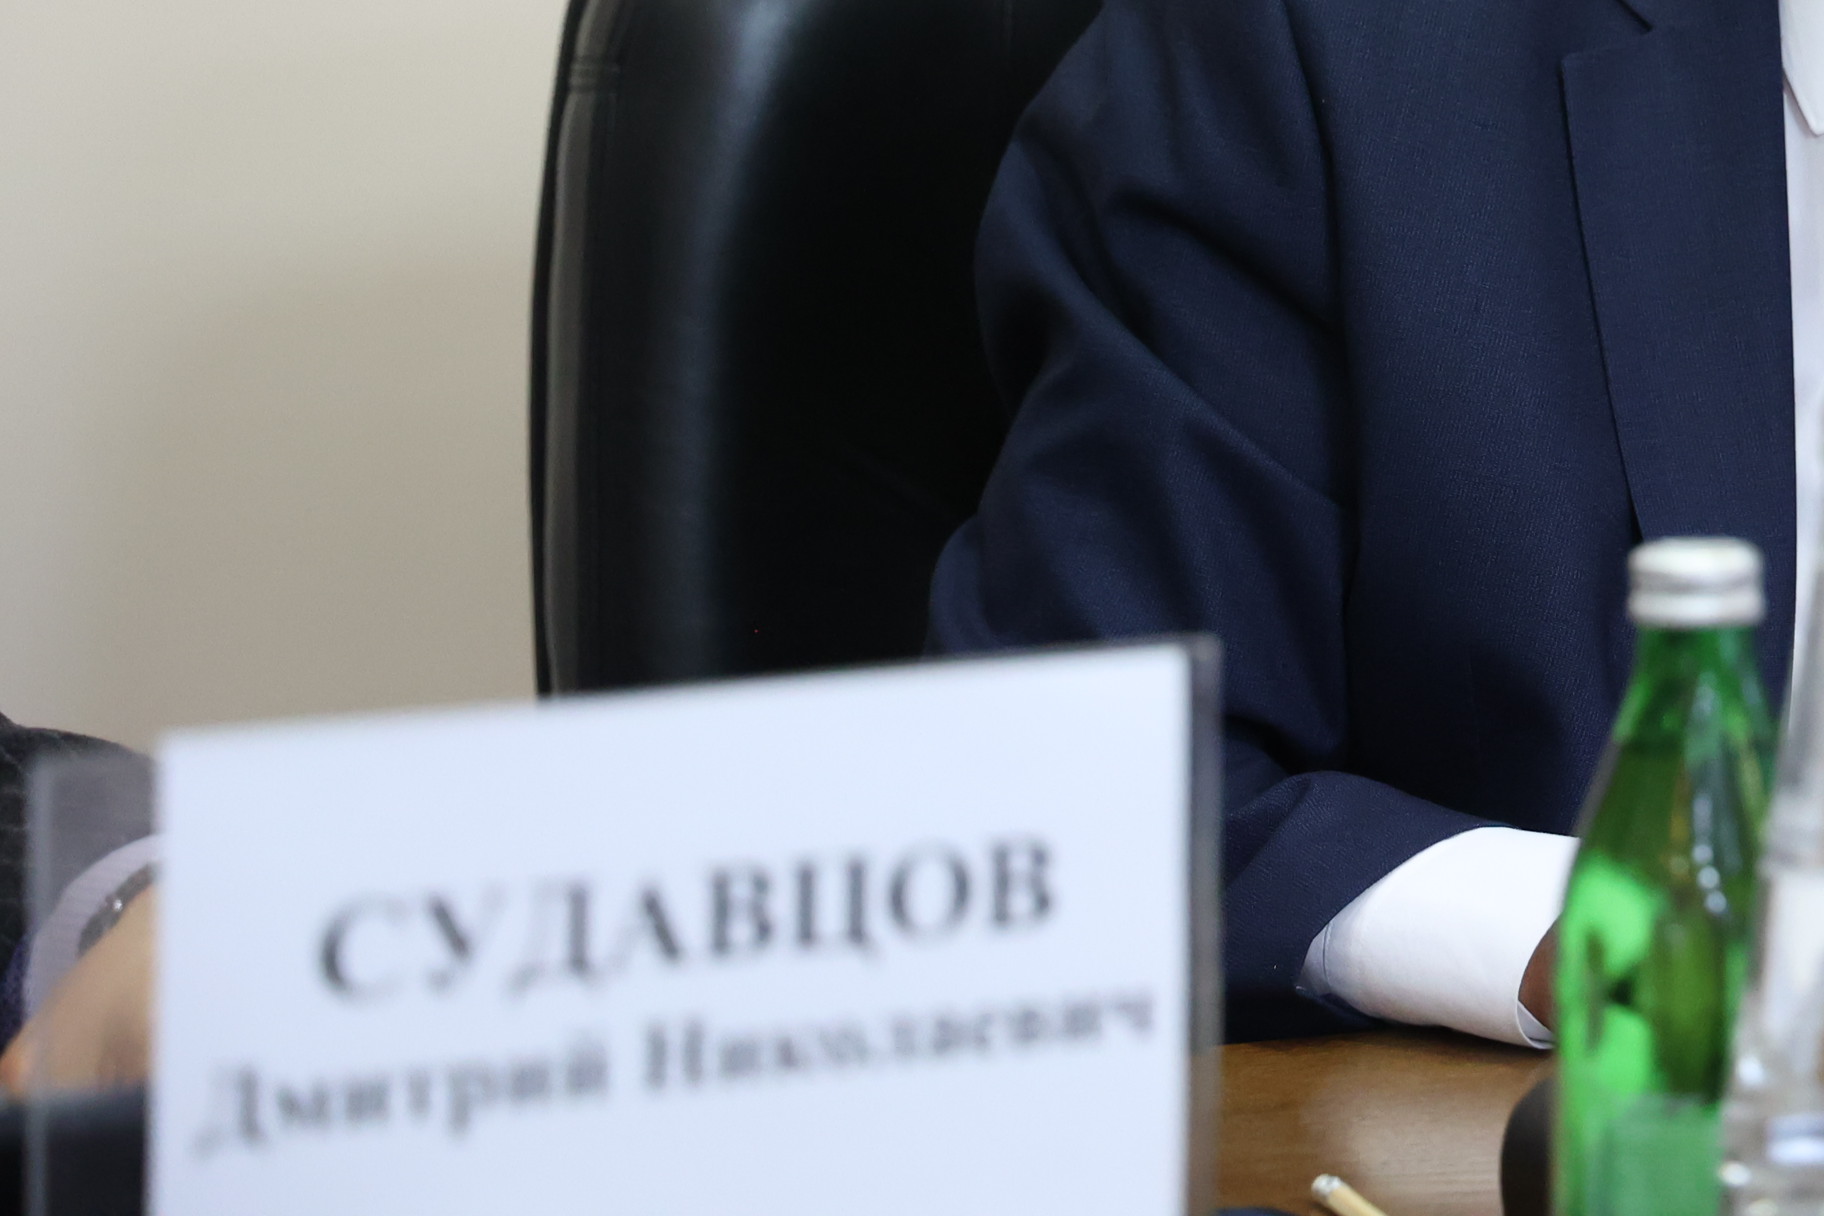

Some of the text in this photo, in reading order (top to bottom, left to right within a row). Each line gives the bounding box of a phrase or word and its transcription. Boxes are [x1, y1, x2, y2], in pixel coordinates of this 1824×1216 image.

[318, 836, 1056, 1001] СУДАВЦОВ
[194, 990, 1156, 1154] Дмитрий Николаевич
